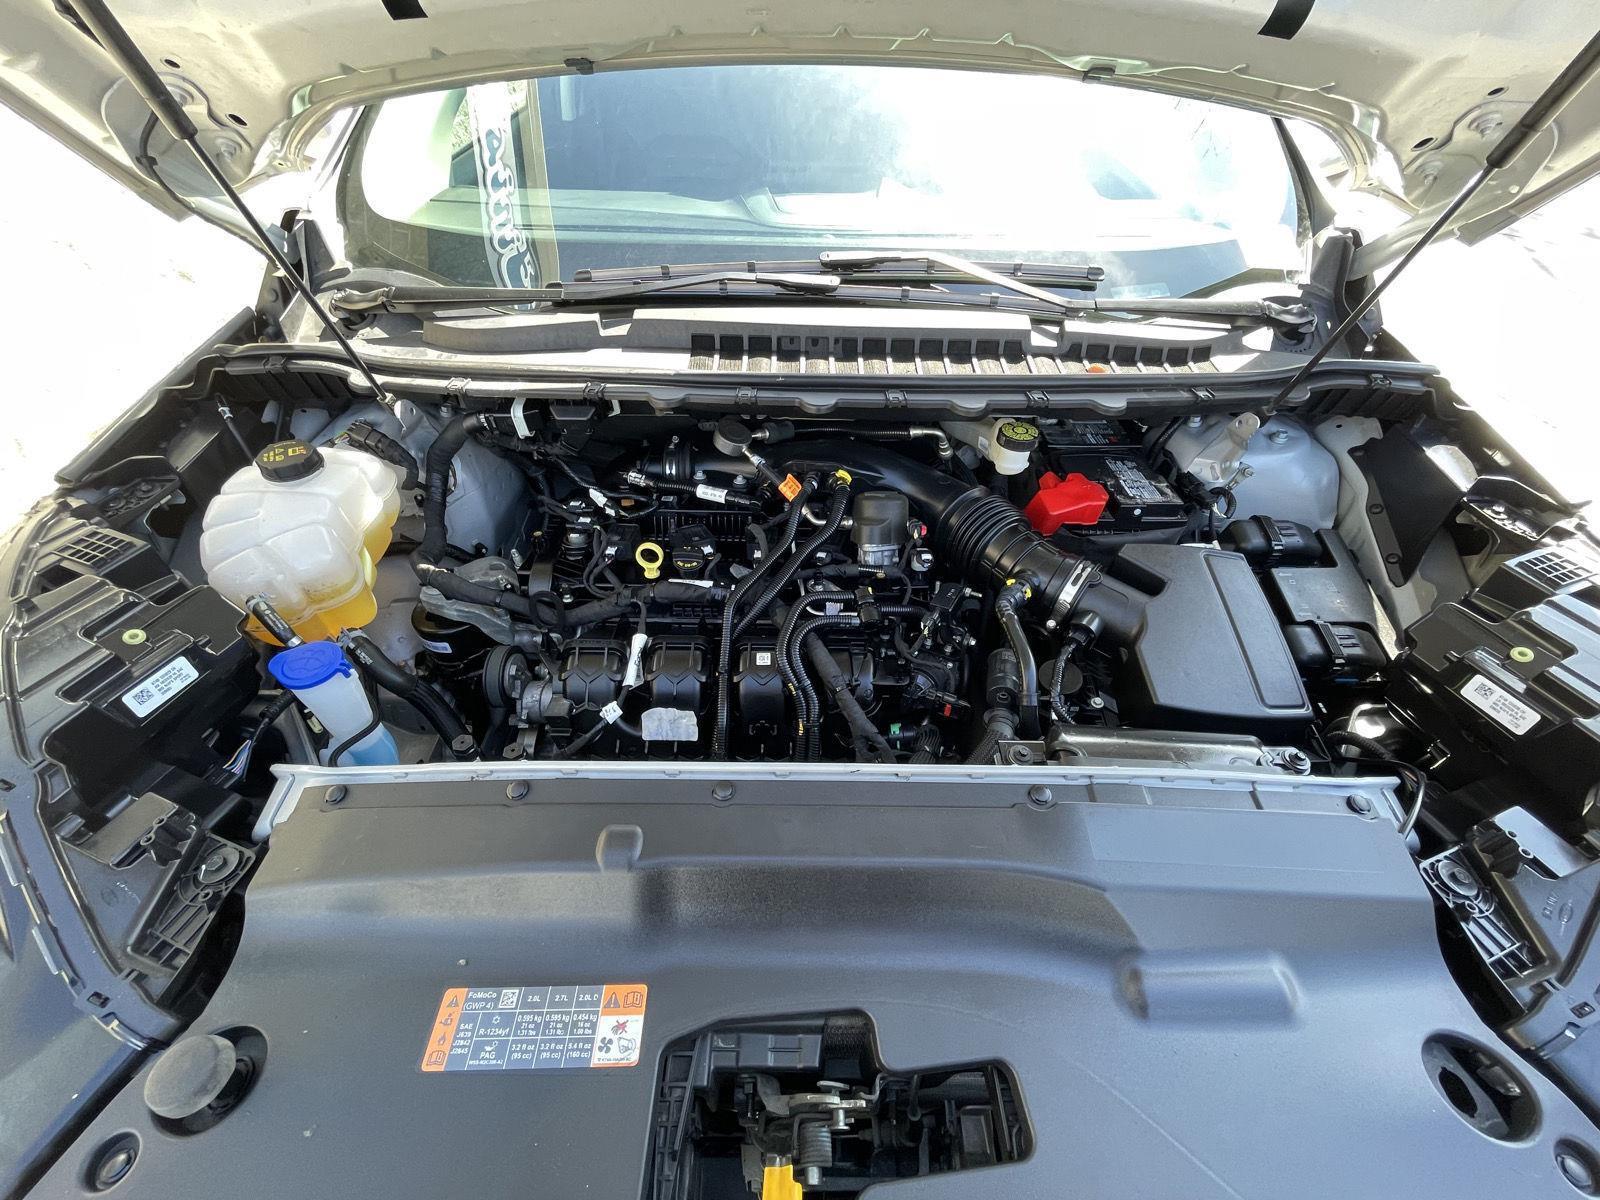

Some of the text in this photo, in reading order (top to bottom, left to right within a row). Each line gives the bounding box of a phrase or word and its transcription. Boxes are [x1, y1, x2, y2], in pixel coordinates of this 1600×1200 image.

[464, 1002, 494, 1010] (GWP 4)
[534, 1014, 542, 1023] kg
[562, 1014, 570, 1022] kg
[590, 1014, 598, 1022] kg
[478, 1028, 510, 1036] R-1234yf
